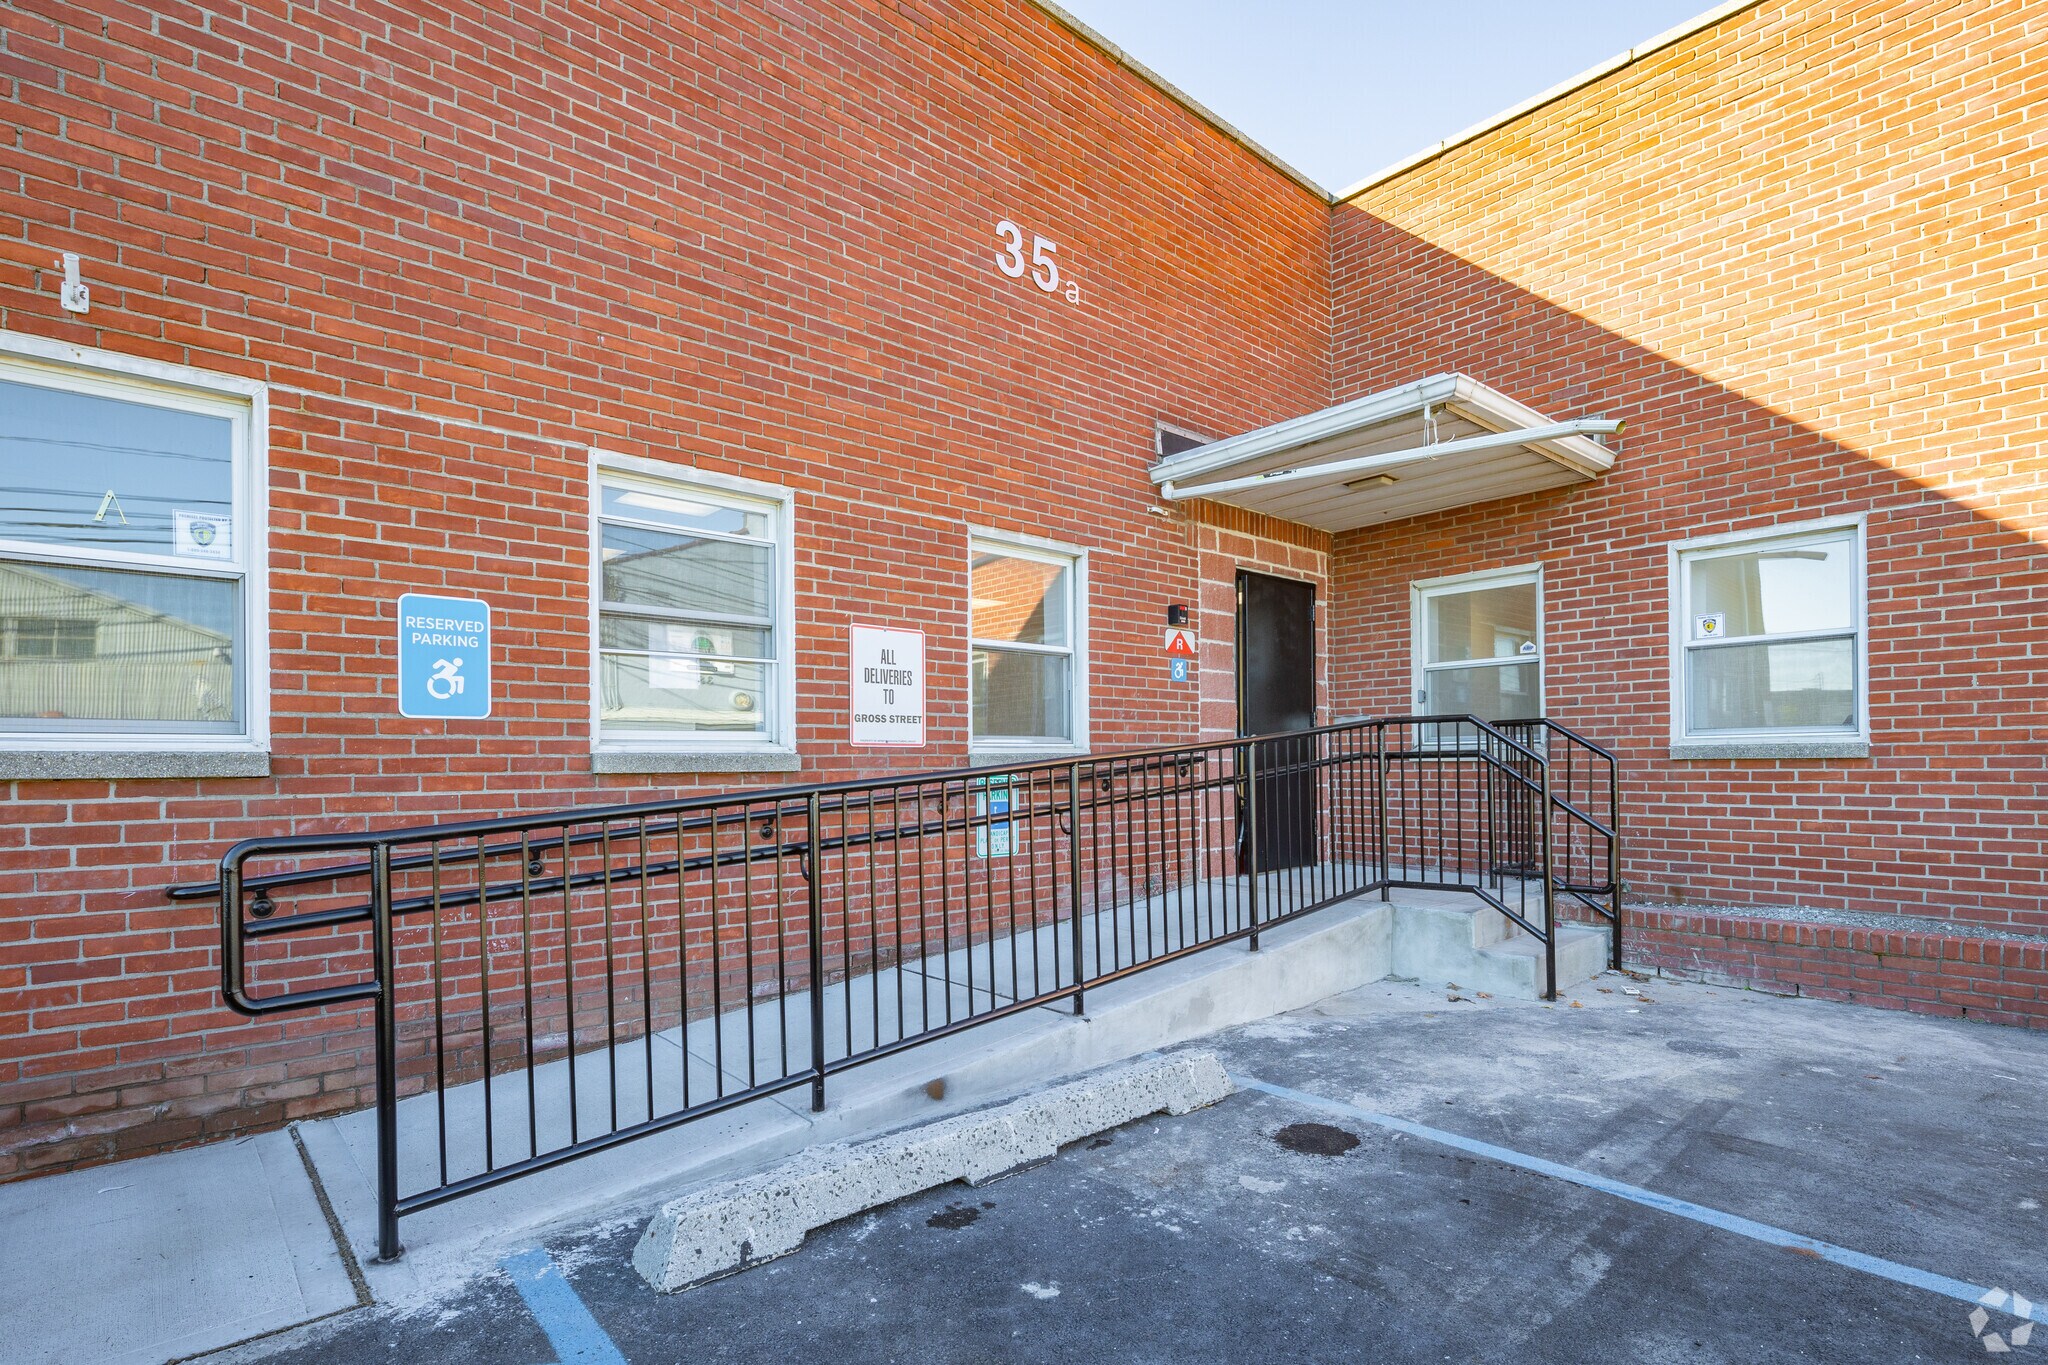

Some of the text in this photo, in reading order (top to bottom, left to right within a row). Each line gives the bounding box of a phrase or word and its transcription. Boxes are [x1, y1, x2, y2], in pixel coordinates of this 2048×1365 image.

[406, 616, 484, 633] RESERVED
[412, 632, 479, 648] PARKING
[1177, 638, 1183, 650] R
[880, 649, 897, 665] ALL
[864, 667, 913, 686] DELIVERIES
[883, 688, 894, 705] TO
[854, 714, 922, 724] GROSS STREET
